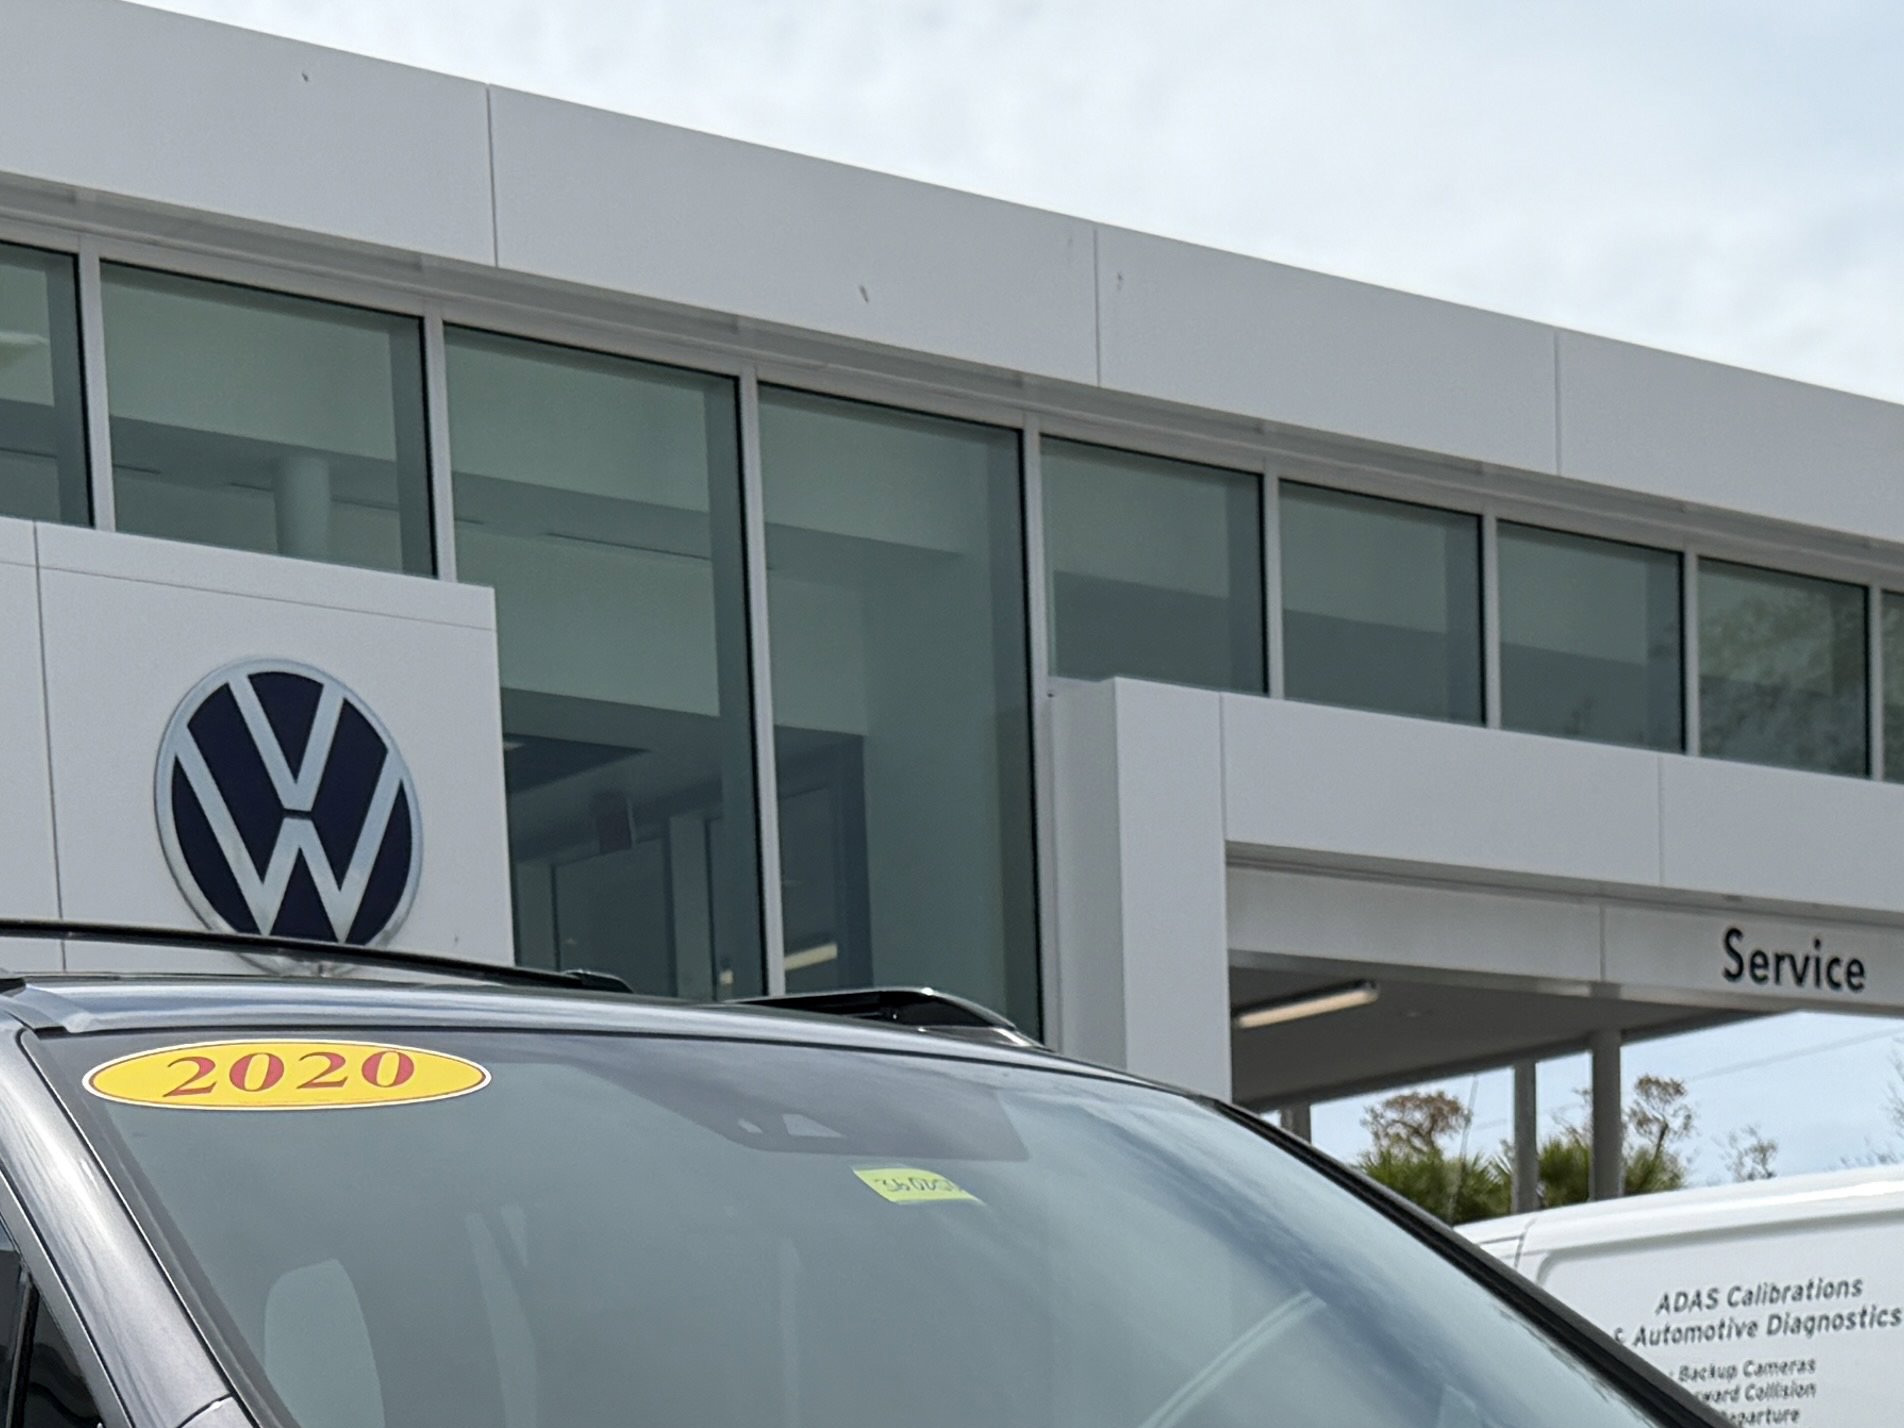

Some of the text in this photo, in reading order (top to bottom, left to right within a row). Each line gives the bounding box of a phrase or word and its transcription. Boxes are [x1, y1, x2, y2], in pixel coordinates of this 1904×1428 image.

[1723, 927, 1866, 993] Service
[162, 1050, 415, 1098] 2020
[1654, 1277, 1864, 1316] ADAS Calibrations
[1632, 1317, 1759, 1349] Automotive
[1765, 1304, 1903, 1338] Diagnostics
[1677, 1358, 1817, 1383] Backup Cameras
[1745, 1382, 1817, 1402] Collision
